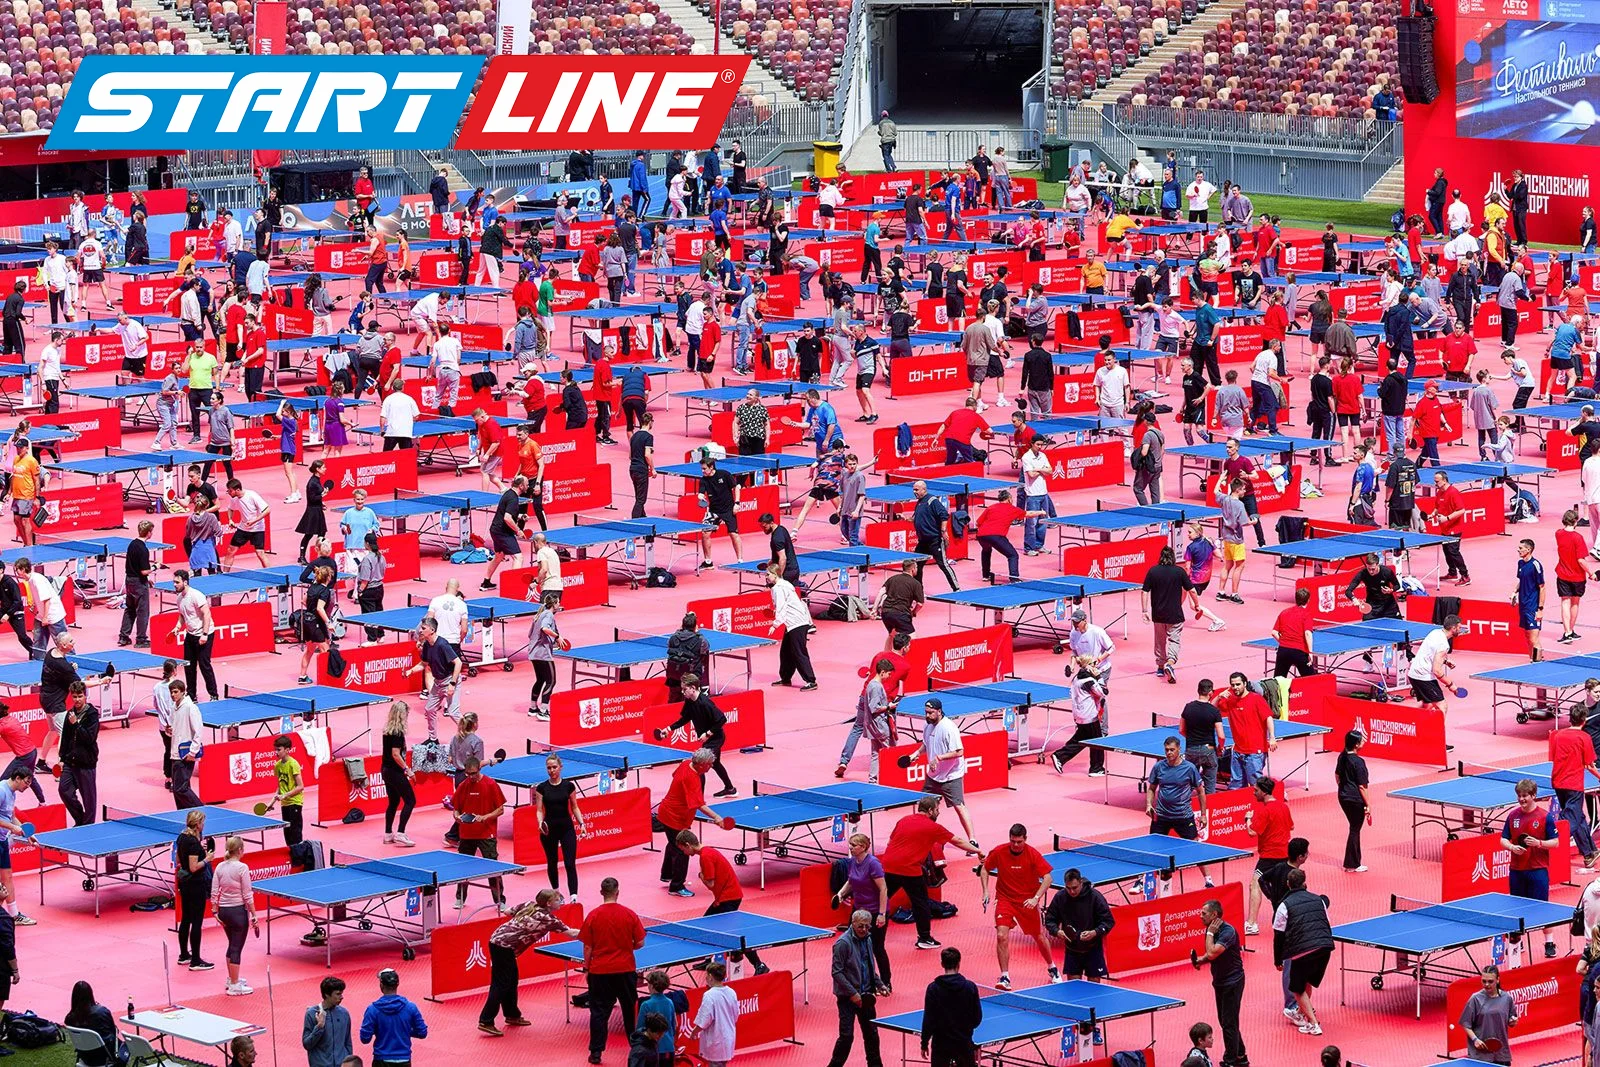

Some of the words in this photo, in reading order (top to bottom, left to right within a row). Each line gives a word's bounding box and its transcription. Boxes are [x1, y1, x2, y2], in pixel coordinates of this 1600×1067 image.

[1496, 41, 1598, 96] Фестиваль
[1515, 84, 1557, 104] Настольного
[1558, 78, 1586, 94] тенниса
[1526, 175, 1589, 198] ОСКОВСКИЙ
[401, 202, 434, 218] ЛЕТ
[1527, 196, 1549, 214] ОРТ
[411, 221, 430, 229] МОС
[1104, 551, 1145, 568] МОСКОВСКИЙ
[1104, 568, 1123, 579] СПОРТ
[944, 641, 987, 659] МОСКОВСКИЙ
[944, 659, 964, 672] СПОРТ
[364, 671, 386, 685] СПОРТ
[604, 706, 623, 714] спорта
[1370, 718, 1416, 736] МОСКОВСКИЙ
[1370, 732, 1393, 746] СПОРТ
[255, 769, 274, 778] город
[572, 809, 614, 822] Дпартамент
[1212, 803, 1251, 817] Департамент
[836, 824, 842, 832] 28
[1212, 817, 1232, 826] спорта
[1212, 825, 1233, 836] города
[1164, 908, 1203, 922] Департаме
[1164, 923, 1187, 932] спорта
[1164, 930, 1188, 943] города
[1496, 945, 1503, 953] 32
[1506, 977, 1558, 1004] ОСКОВСКИЙ
